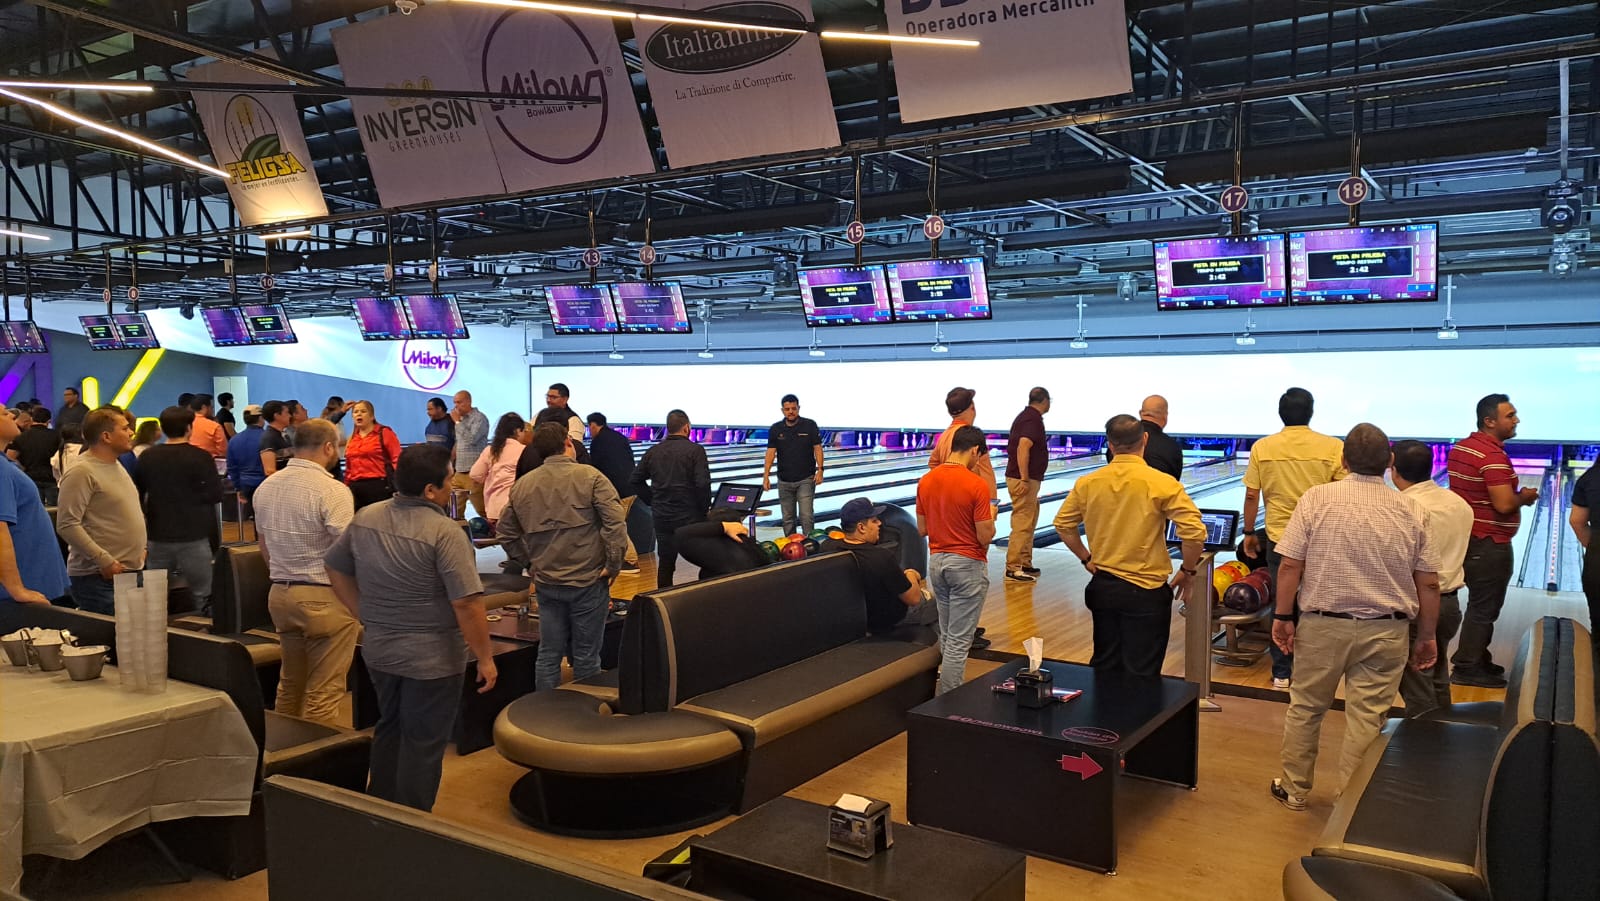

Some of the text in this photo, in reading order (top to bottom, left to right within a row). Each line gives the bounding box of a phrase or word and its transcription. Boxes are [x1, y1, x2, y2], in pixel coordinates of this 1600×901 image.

[905, 10, 997, 37] Operadora
[687, 83, 731, 98] Tradizione
[732, 79, 742, 90] di
[363, 99, 477, 143] INVERSIN
[225, 152, 307, 184] FELIGSA
[1341, 182, 1363, 199] 18
[1224, 191, 1243, 207] 17
[849, 226, 863, 238] 15
[926, 222, 941, 234] 16
[585, 253, 599, 262] 13
[642, 250, 653, 260] 14
[262, 278, 272, 287] 10
